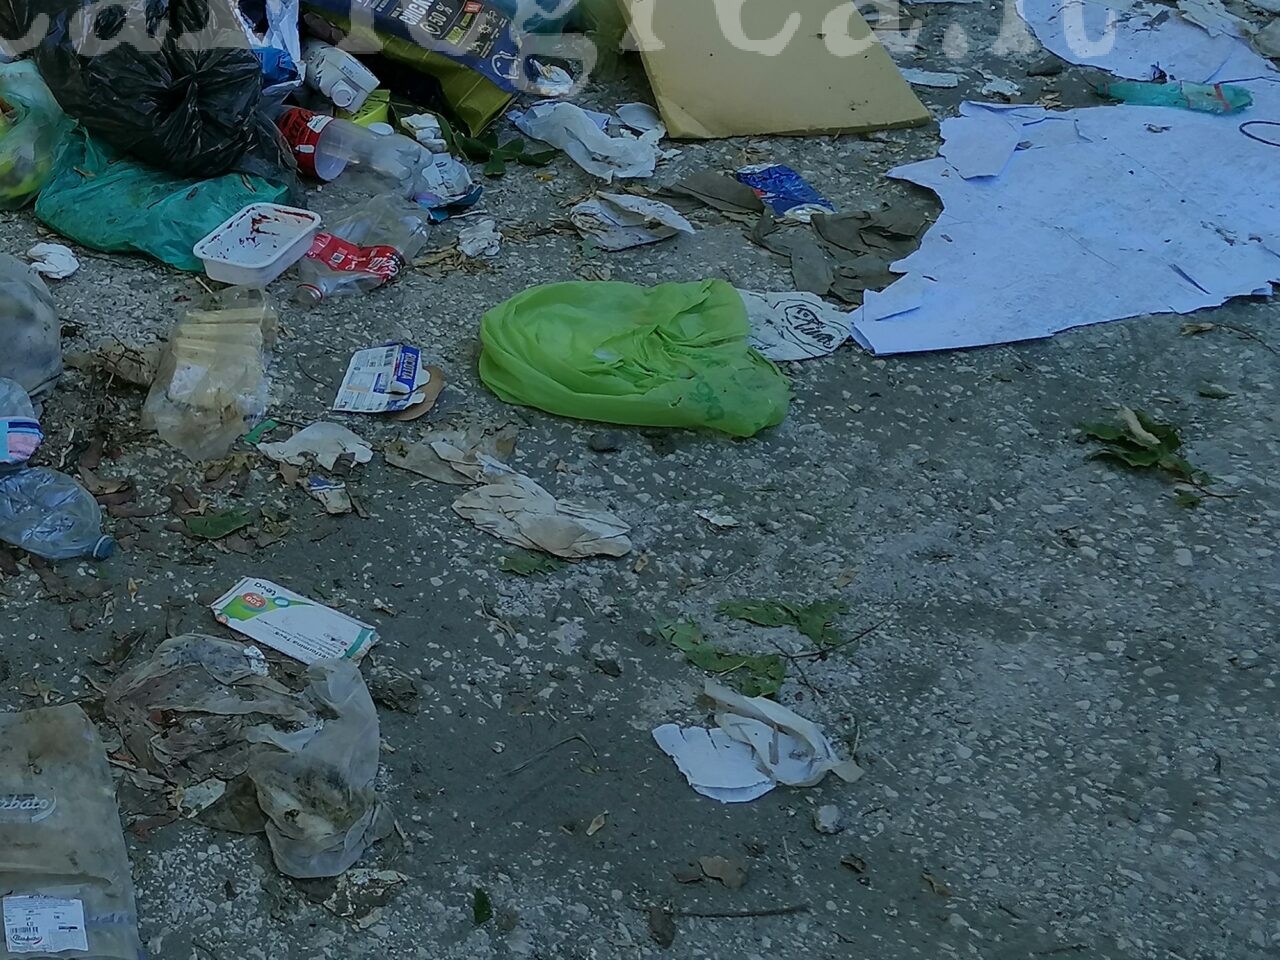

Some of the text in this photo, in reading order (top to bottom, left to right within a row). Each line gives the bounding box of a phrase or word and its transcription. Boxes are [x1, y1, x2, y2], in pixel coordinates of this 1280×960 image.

[428, 11, 448, 27] 50
[254, 581, 277, 597] teva
[245, 595, 263, 608] 500
